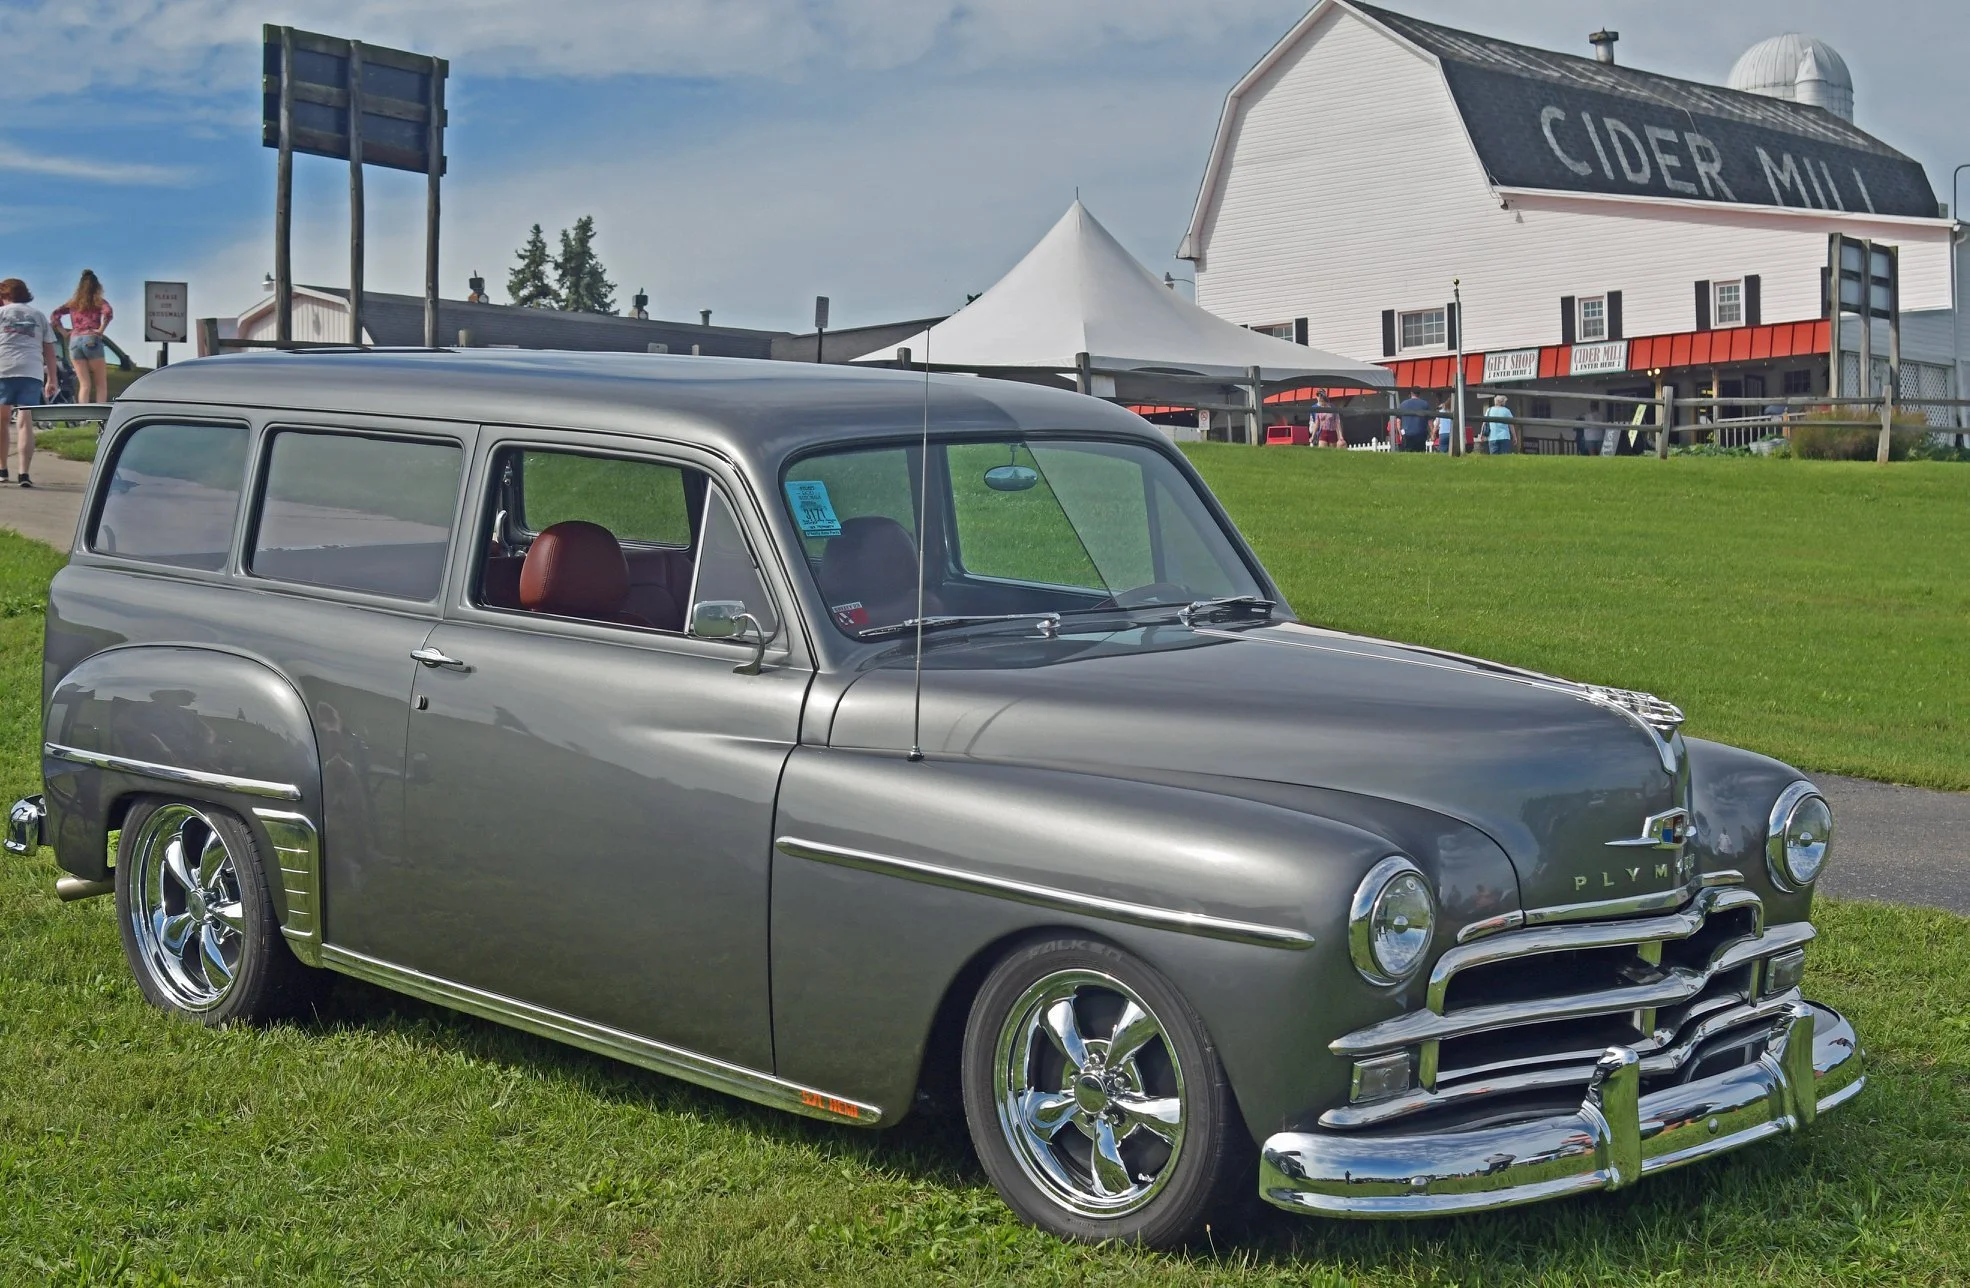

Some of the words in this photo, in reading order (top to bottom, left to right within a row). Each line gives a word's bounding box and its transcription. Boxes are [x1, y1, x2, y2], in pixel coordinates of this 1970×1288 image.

[1540, 104, 1737, 200] CIDER
[1487, 355, 1508, 372] GIFT
[1510, 352, 1536, 370] SHOP
[1573, 347, 1600, 364] CIDER
[1602, 344, 1624, 362] MILL
